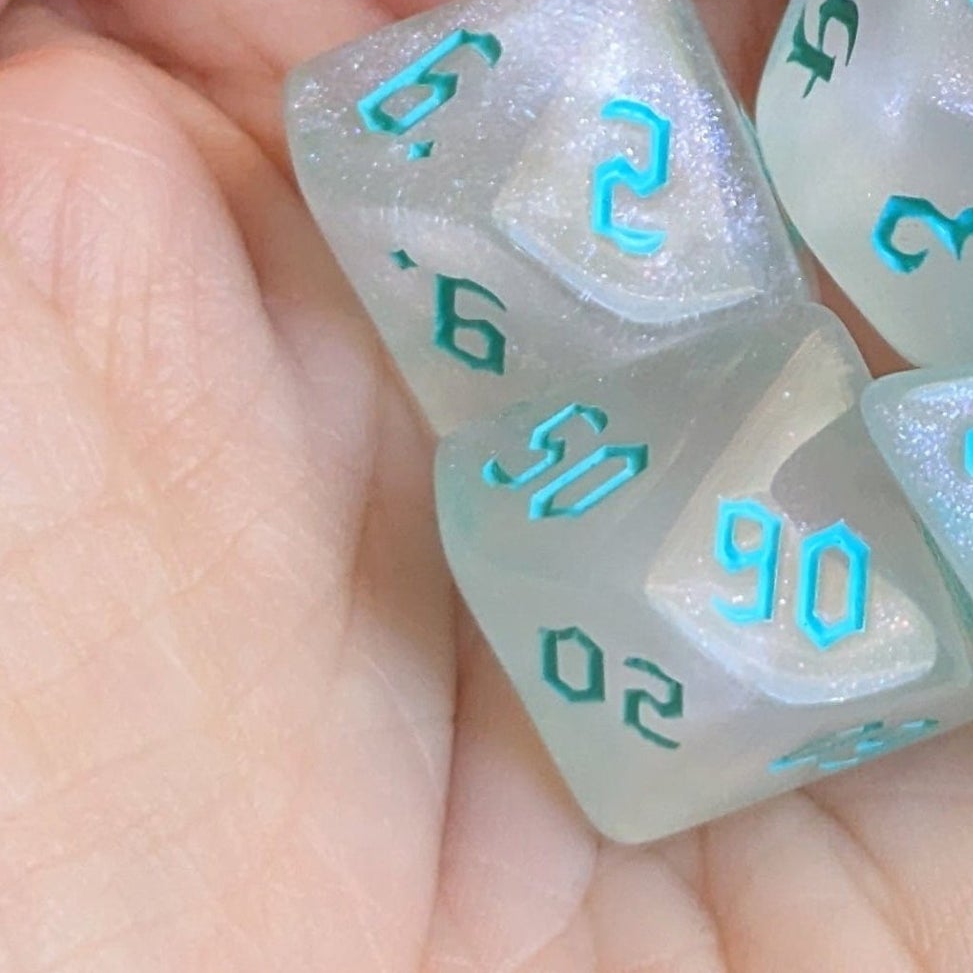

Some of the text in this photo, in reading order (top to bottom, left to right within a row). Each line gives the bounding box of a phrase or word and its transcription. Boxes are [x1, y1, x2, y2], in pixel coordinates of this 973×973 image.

[592, 98, 671, 255] 2
[482, 402, 648, 521] 50
[710, 496, 871, 650] 90
[538, 625, 684, 750] 20
